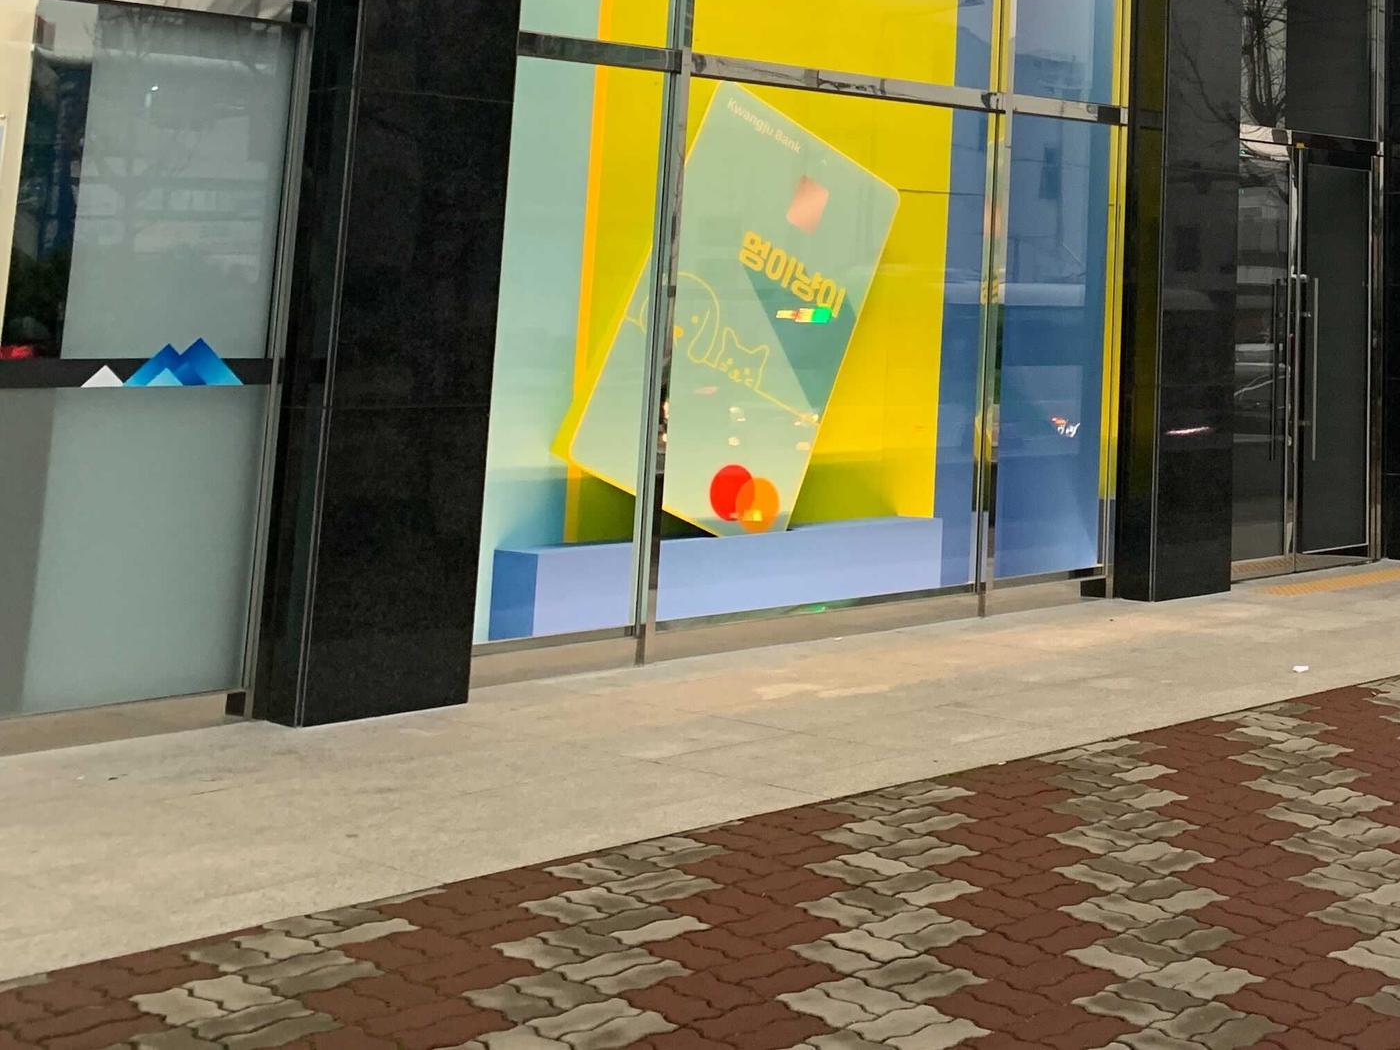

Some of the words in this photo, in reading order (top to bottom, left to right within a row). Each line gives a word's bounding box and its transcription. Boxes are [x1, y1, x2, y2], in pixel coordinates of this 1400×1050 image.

[727, 97, 774, 136] Kwangju
[775, 129, 801, 153] Bank
[739, 230, 847, 318] 멍이냥이
